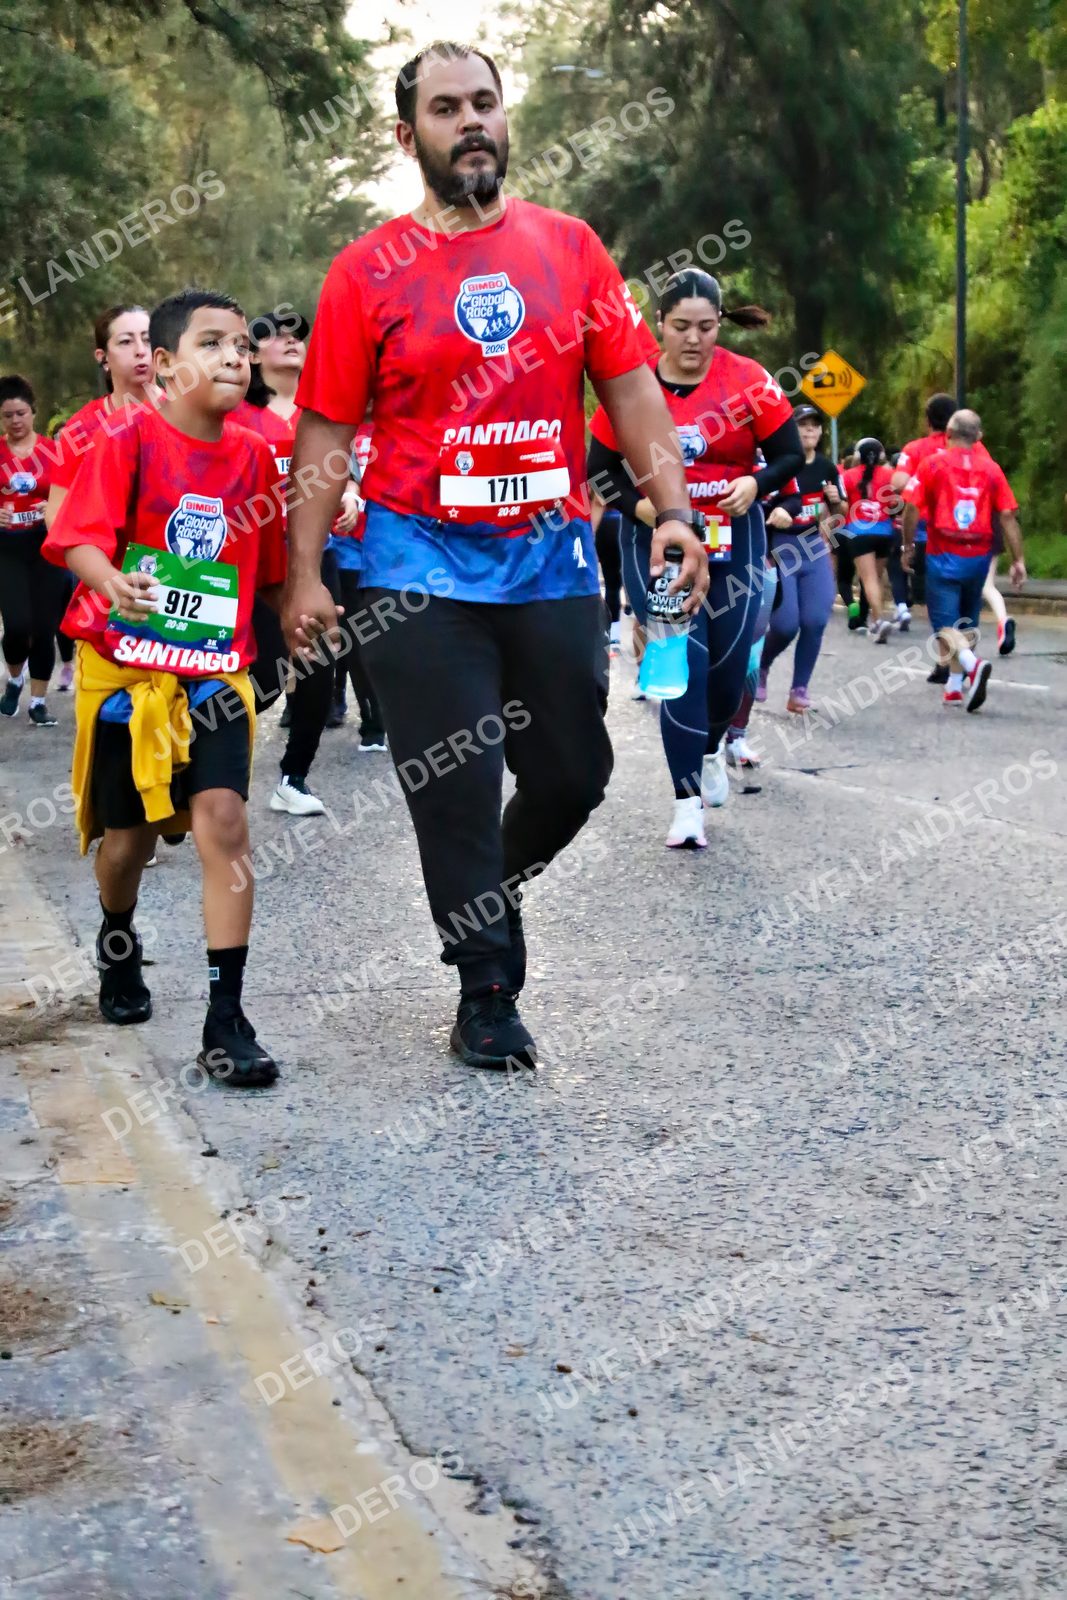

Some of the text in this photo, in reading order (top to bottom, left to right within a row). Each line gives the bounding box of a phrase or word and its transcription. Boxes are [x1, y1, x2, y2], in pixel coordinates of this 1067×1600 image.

[467, 279, 503, 293] BIMBO
[471, 292, 506, 307] Global
[466, 306, 494, 319] Race
[485, 343, 506, 355] 2026
[442, 418, 562, 447] SANTIAGO
[487, 475, 528, 503] 1711
[686, 479, 728, 499] TIAGO
[185, 501, 218, 514] BIMBO
[497, 505, 521, 518] 20-26
[184, 514, 216, 531] Global
[175, 524, 203, 540] Race
[164, 589, 203, 620] 912
[647, 590, 684, 607] POWER
[164, 619, 189, 632] 20-26
[113, 633, 241, 673] SANTIAGO
